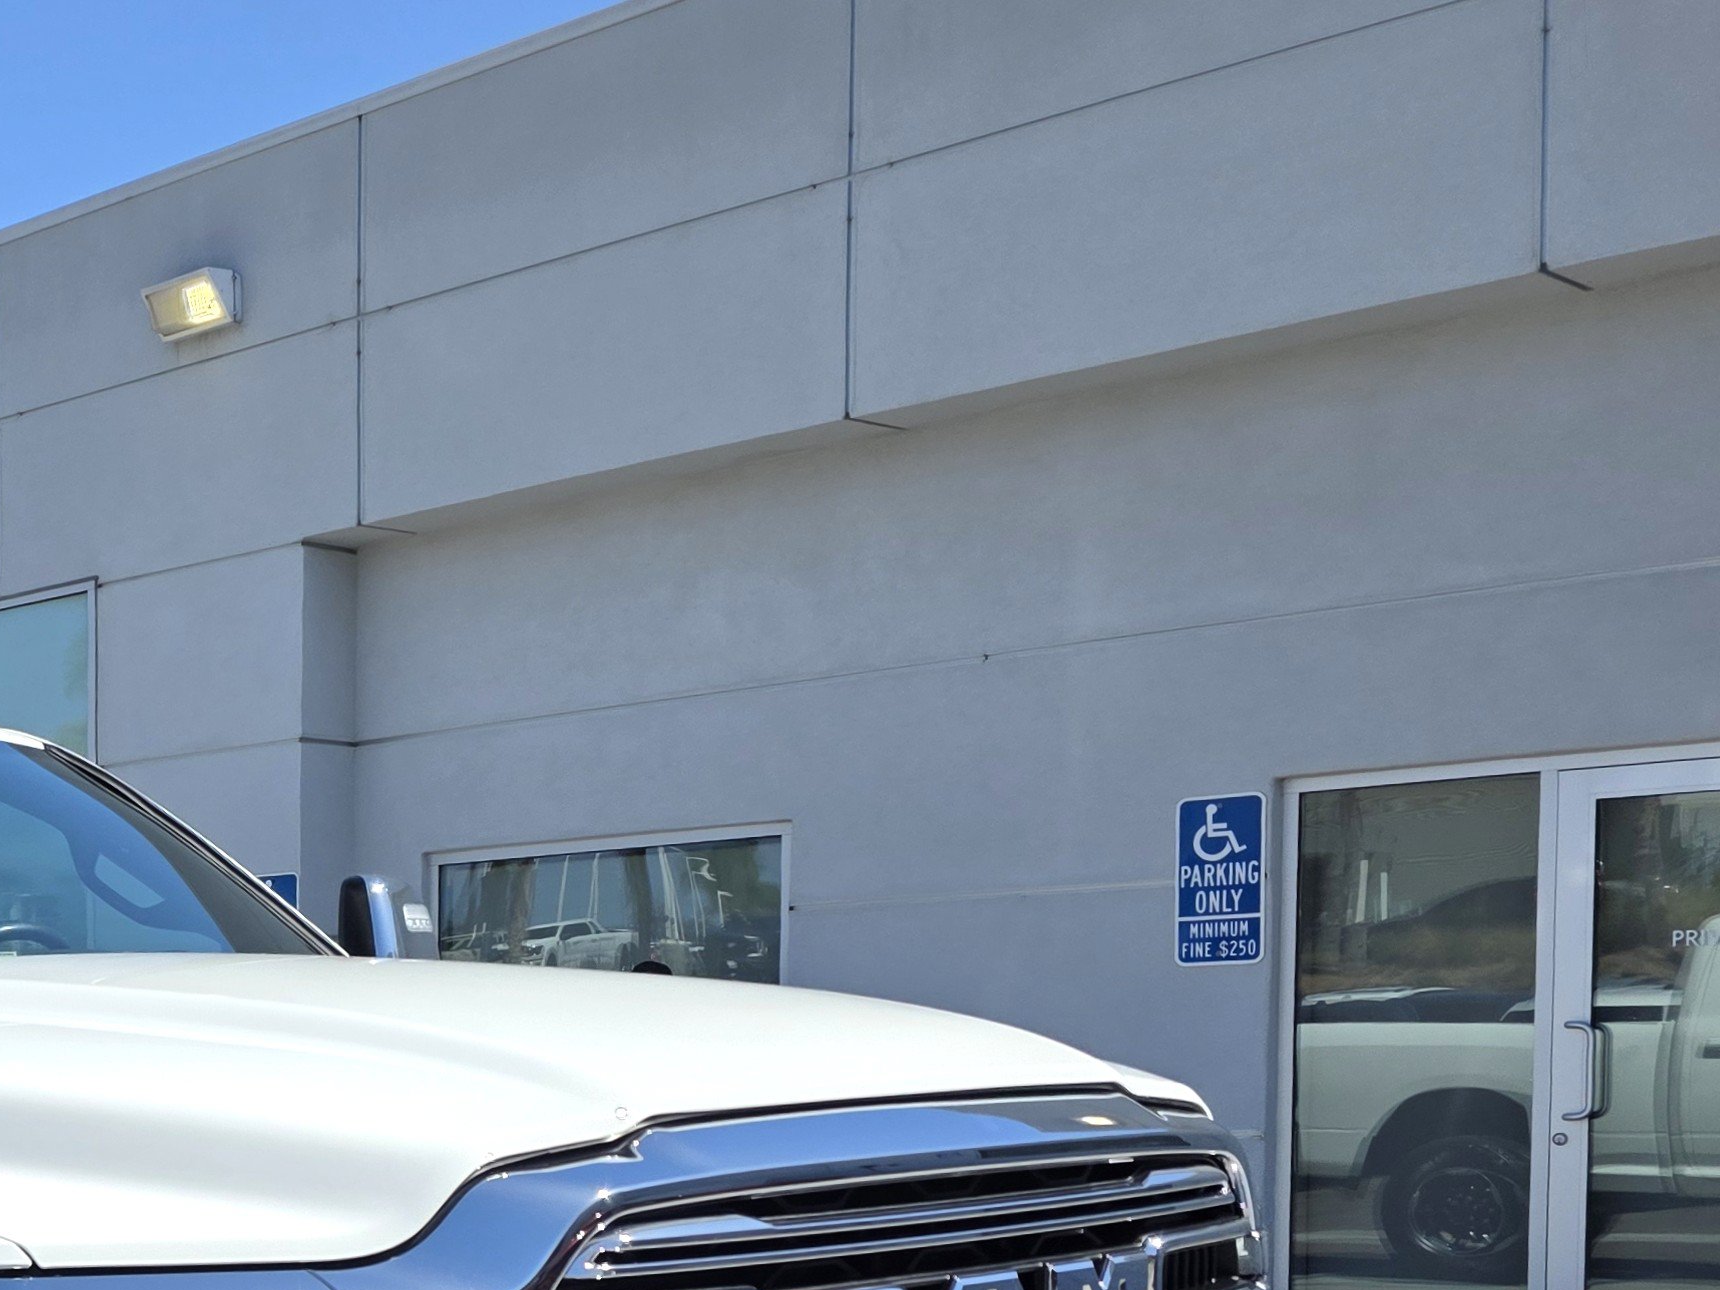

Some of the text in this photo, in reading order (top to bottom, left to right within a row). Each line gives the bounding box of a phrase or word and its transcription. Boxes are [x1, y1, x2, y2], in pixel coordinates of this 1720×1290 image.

[1180, 860, 1259, 888] PARKING
[1195, 888, 1243, 914] ONLY
[1189, 920, 1249, 939] MINIMUM
[1671, 929, 1720, 948] PRI
[1182, 939, 1257, 958] FINE $250
